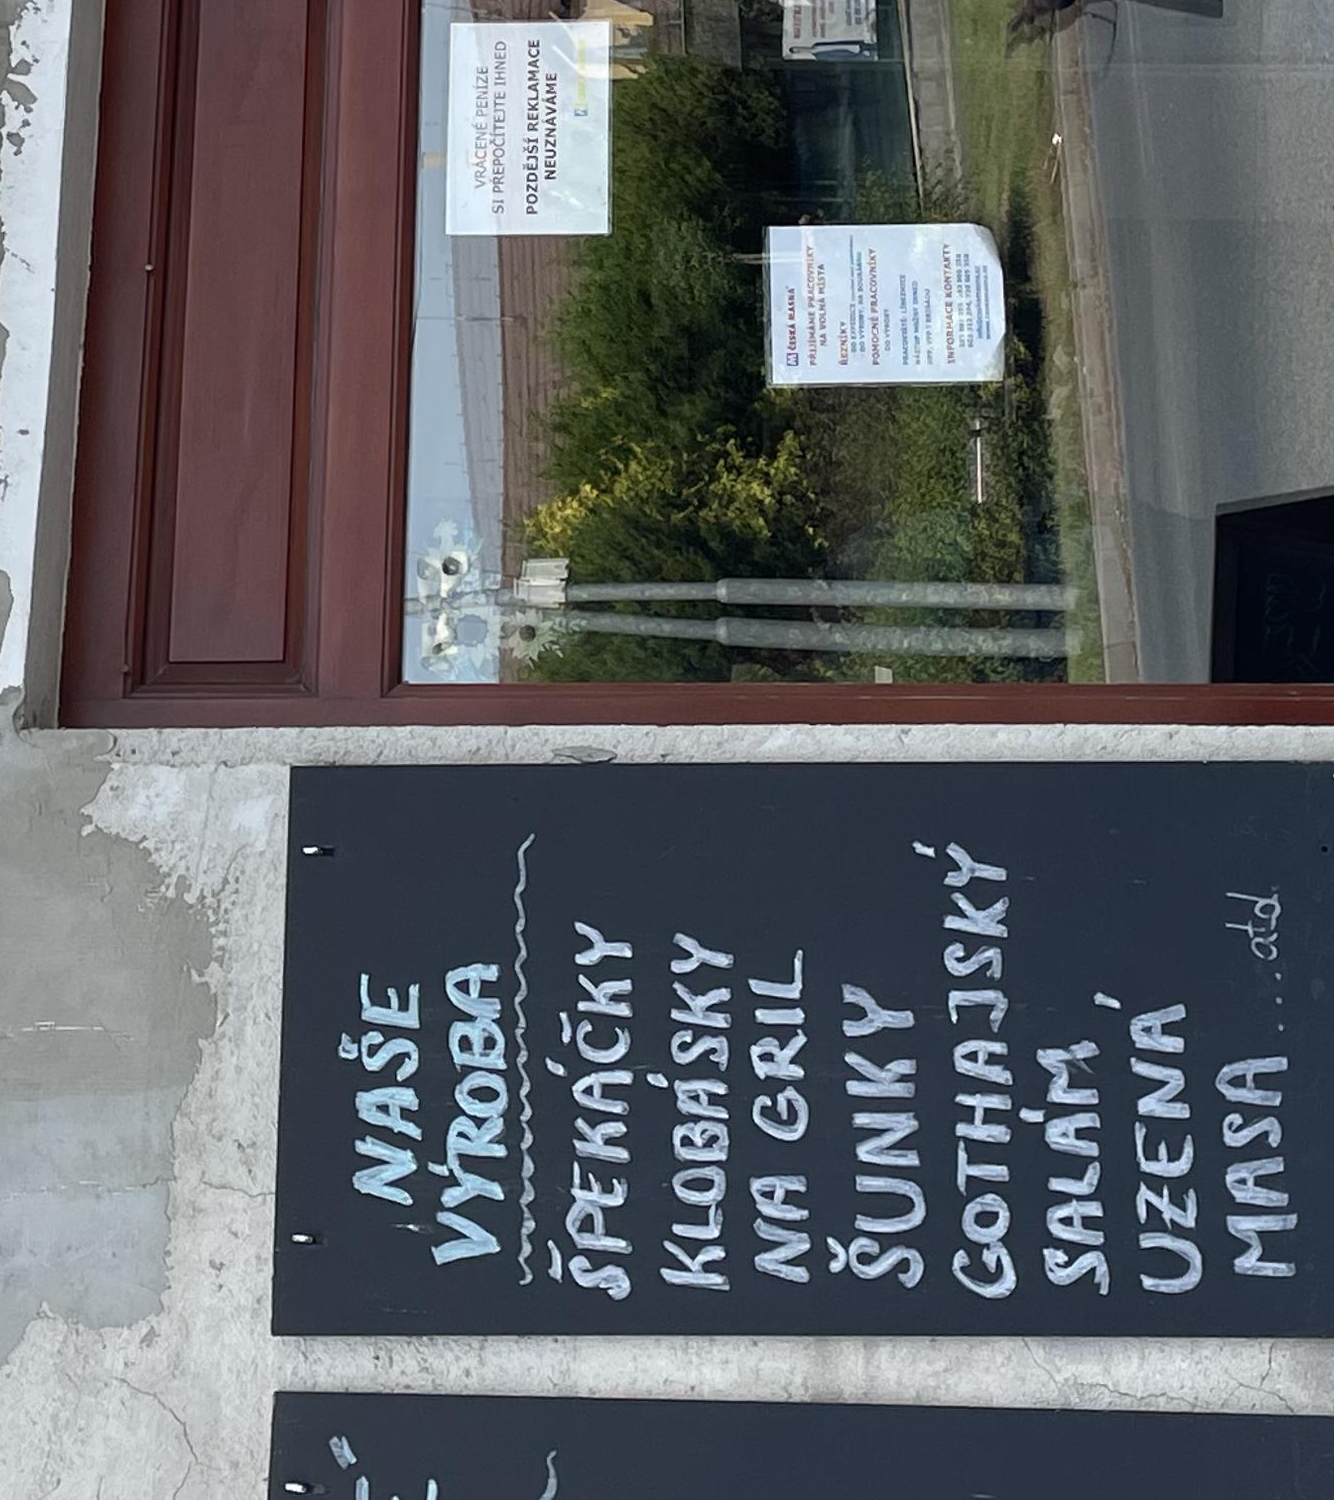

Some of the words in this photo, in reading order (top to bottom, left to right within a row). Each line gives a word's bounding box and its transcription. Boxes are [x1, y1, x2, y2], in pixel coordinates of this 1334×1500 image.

[472, 66, 489, 117] PENÍZE
[494, 40, 507, 86] IHNED
[527, 39, 540, 132] REKLAMACE
[471, 122, 488, 189] VRÁCENÉ
[489, 91, 506, 194] PŘEPOČÍTEJTE
[542, 72, 557, 180] NEUZNÁVÁME
[492, 199, 505, 214] SI
[523, 136, 539, 215] POZDĚJŠÍ
[805, 245, 816, 308] PRACOVNÍKY
[816, 264, 826, 294] MÍSTA
[867, 248, 878, 313] PRACOVNÍKY
[942, 243, 953, 298] KONTAKTY
[818, 333, 827, 347] NA
[838, 321, 849, 366] ŘEZNÍKY
[868, 316, 880, 366] POMOCNÉ
[945, 301, 956, 364] INFORMACE
[338, 973, 422, 1205] NAŠE
[748, 949, 809, 1141] GRIL
[912, 841, 1016, 1299] GOTHAJSKÝ
[428, 963, 509, 1265] VÝROBA
[546, 921, 633, 1300] ŠPEKÁČKY
[646, 932, 734, 1291] KLOBÁSKY
[826, 984, 926, 1289] ŠUNKY
[1094, 992, 1202, 1294] UZENÁ
[1019, 1039, 1109, 1296] SALÁM
[1215, 1055, 1298, 1277] MASA
[749, 1174, 811, 1283] NA
